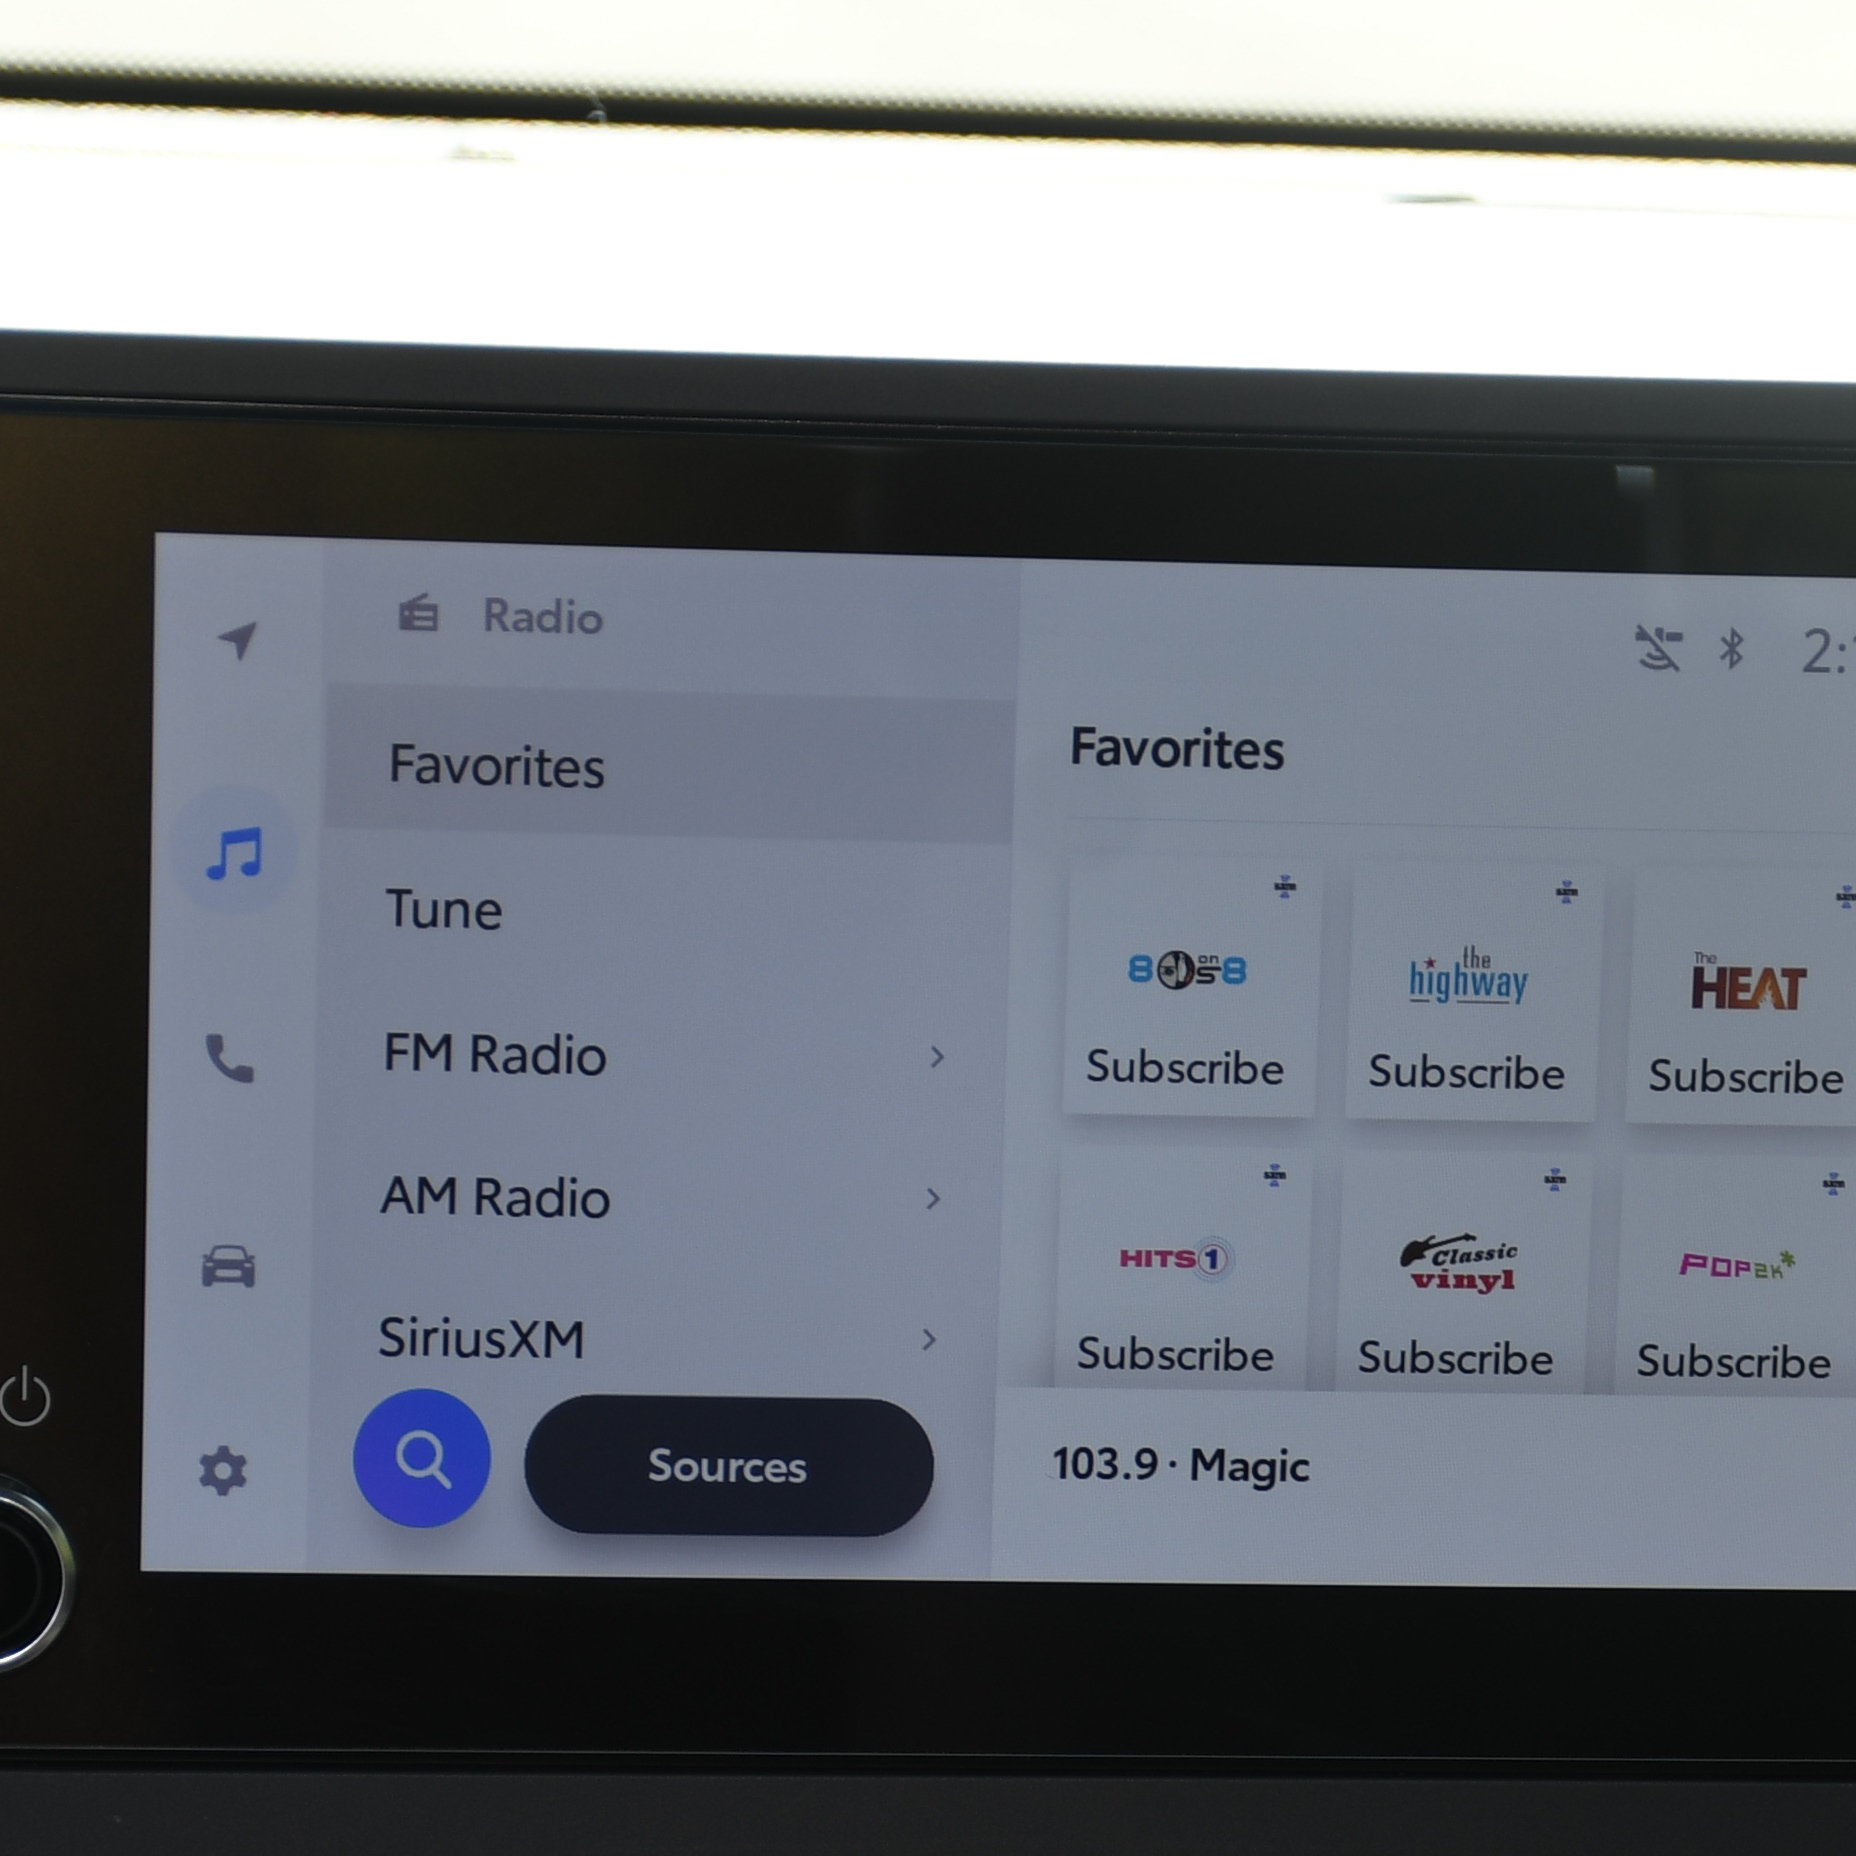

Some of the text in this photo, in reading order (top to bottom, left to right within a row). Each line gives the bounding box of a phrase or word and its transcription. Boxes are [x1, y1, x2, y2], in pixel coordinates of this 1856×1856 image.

[484, 597, 604, 636] Radio
[389, 742, 606, 789] Favorites
[1070, 726, 1285, 772] Favorites
[386, 888, 504, 931] Tune
[1463, 945, 1491, 969] the
[1695, 951, 1717, 965] The
[1410, 961, 1528, 1005] highway
[1692, 966, 1807, 1009] HEAT
[385, 1033, 607, 1077] FM Radio
[1087, 1049, 1284, 1087] Subscribe
[1369, 1053, 1565, 1091] Subscribe
[1648, 1059, 1844, 1097] Subscribe
[380, 1176, 611, 1220] AM Radio
[1432, 1241, 1518, 1268] Classic
[1411, 1268, 1515, 1295] vinyl
[380, 1316, 584, 1360] SiriusXM
[1077, 1336, 1274, 1373] Subscribe
[1358, 1340, 1554, 1377] Subscribe
[1637, 1343, 1832, 1382] Subscribe
[649, 1447, 808, 1485] Sources
[1052, 1447, 1311, 1492] 103.9 Magic
